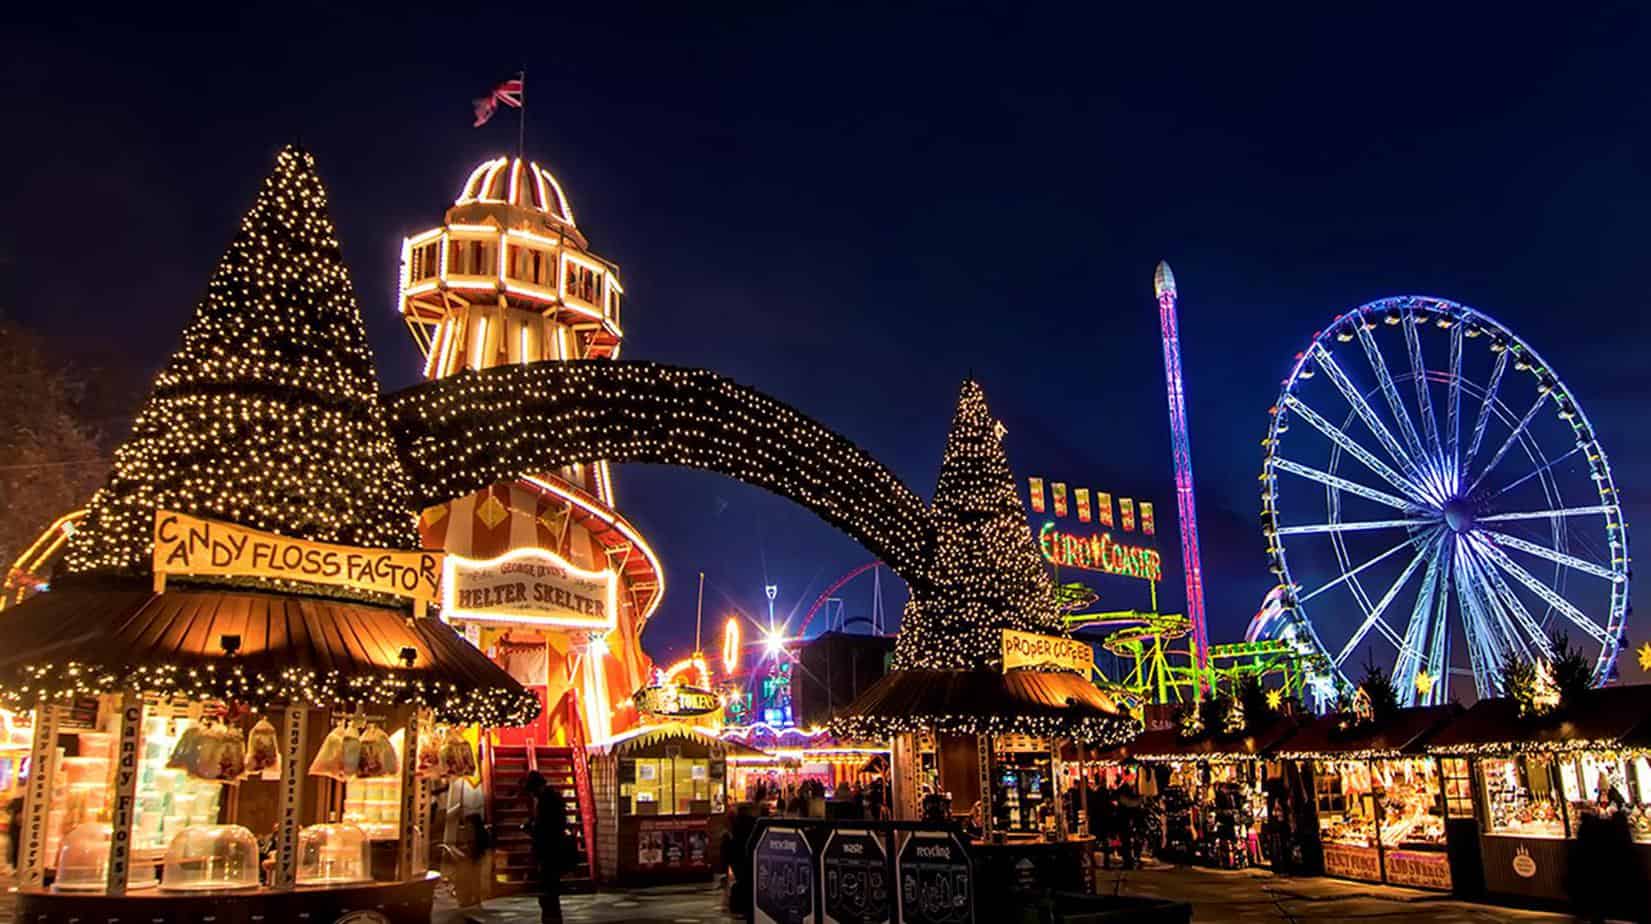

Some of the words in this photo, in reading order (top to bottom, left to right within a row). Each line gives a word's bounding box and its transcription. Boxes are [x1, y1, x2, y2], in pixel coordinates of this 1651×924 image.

[158, 516, 248, 568] CANDY
[252, 542, 341, 577] FLOSS
[346, 554, 442, 597] FACTORY
[458, 582, 527, 609] HELTER
[533, 582, 606, 618] SKELTER
[1006, 636, 1051, 659] PROPER
[1053, 641, 1090, 664] COFFEE
[120, 707, 138, 786] Candy
[290, 711, 301, 755] Candy
[288, 759, 299, 803] Floss
[115, 795, 129, 873] Floss
